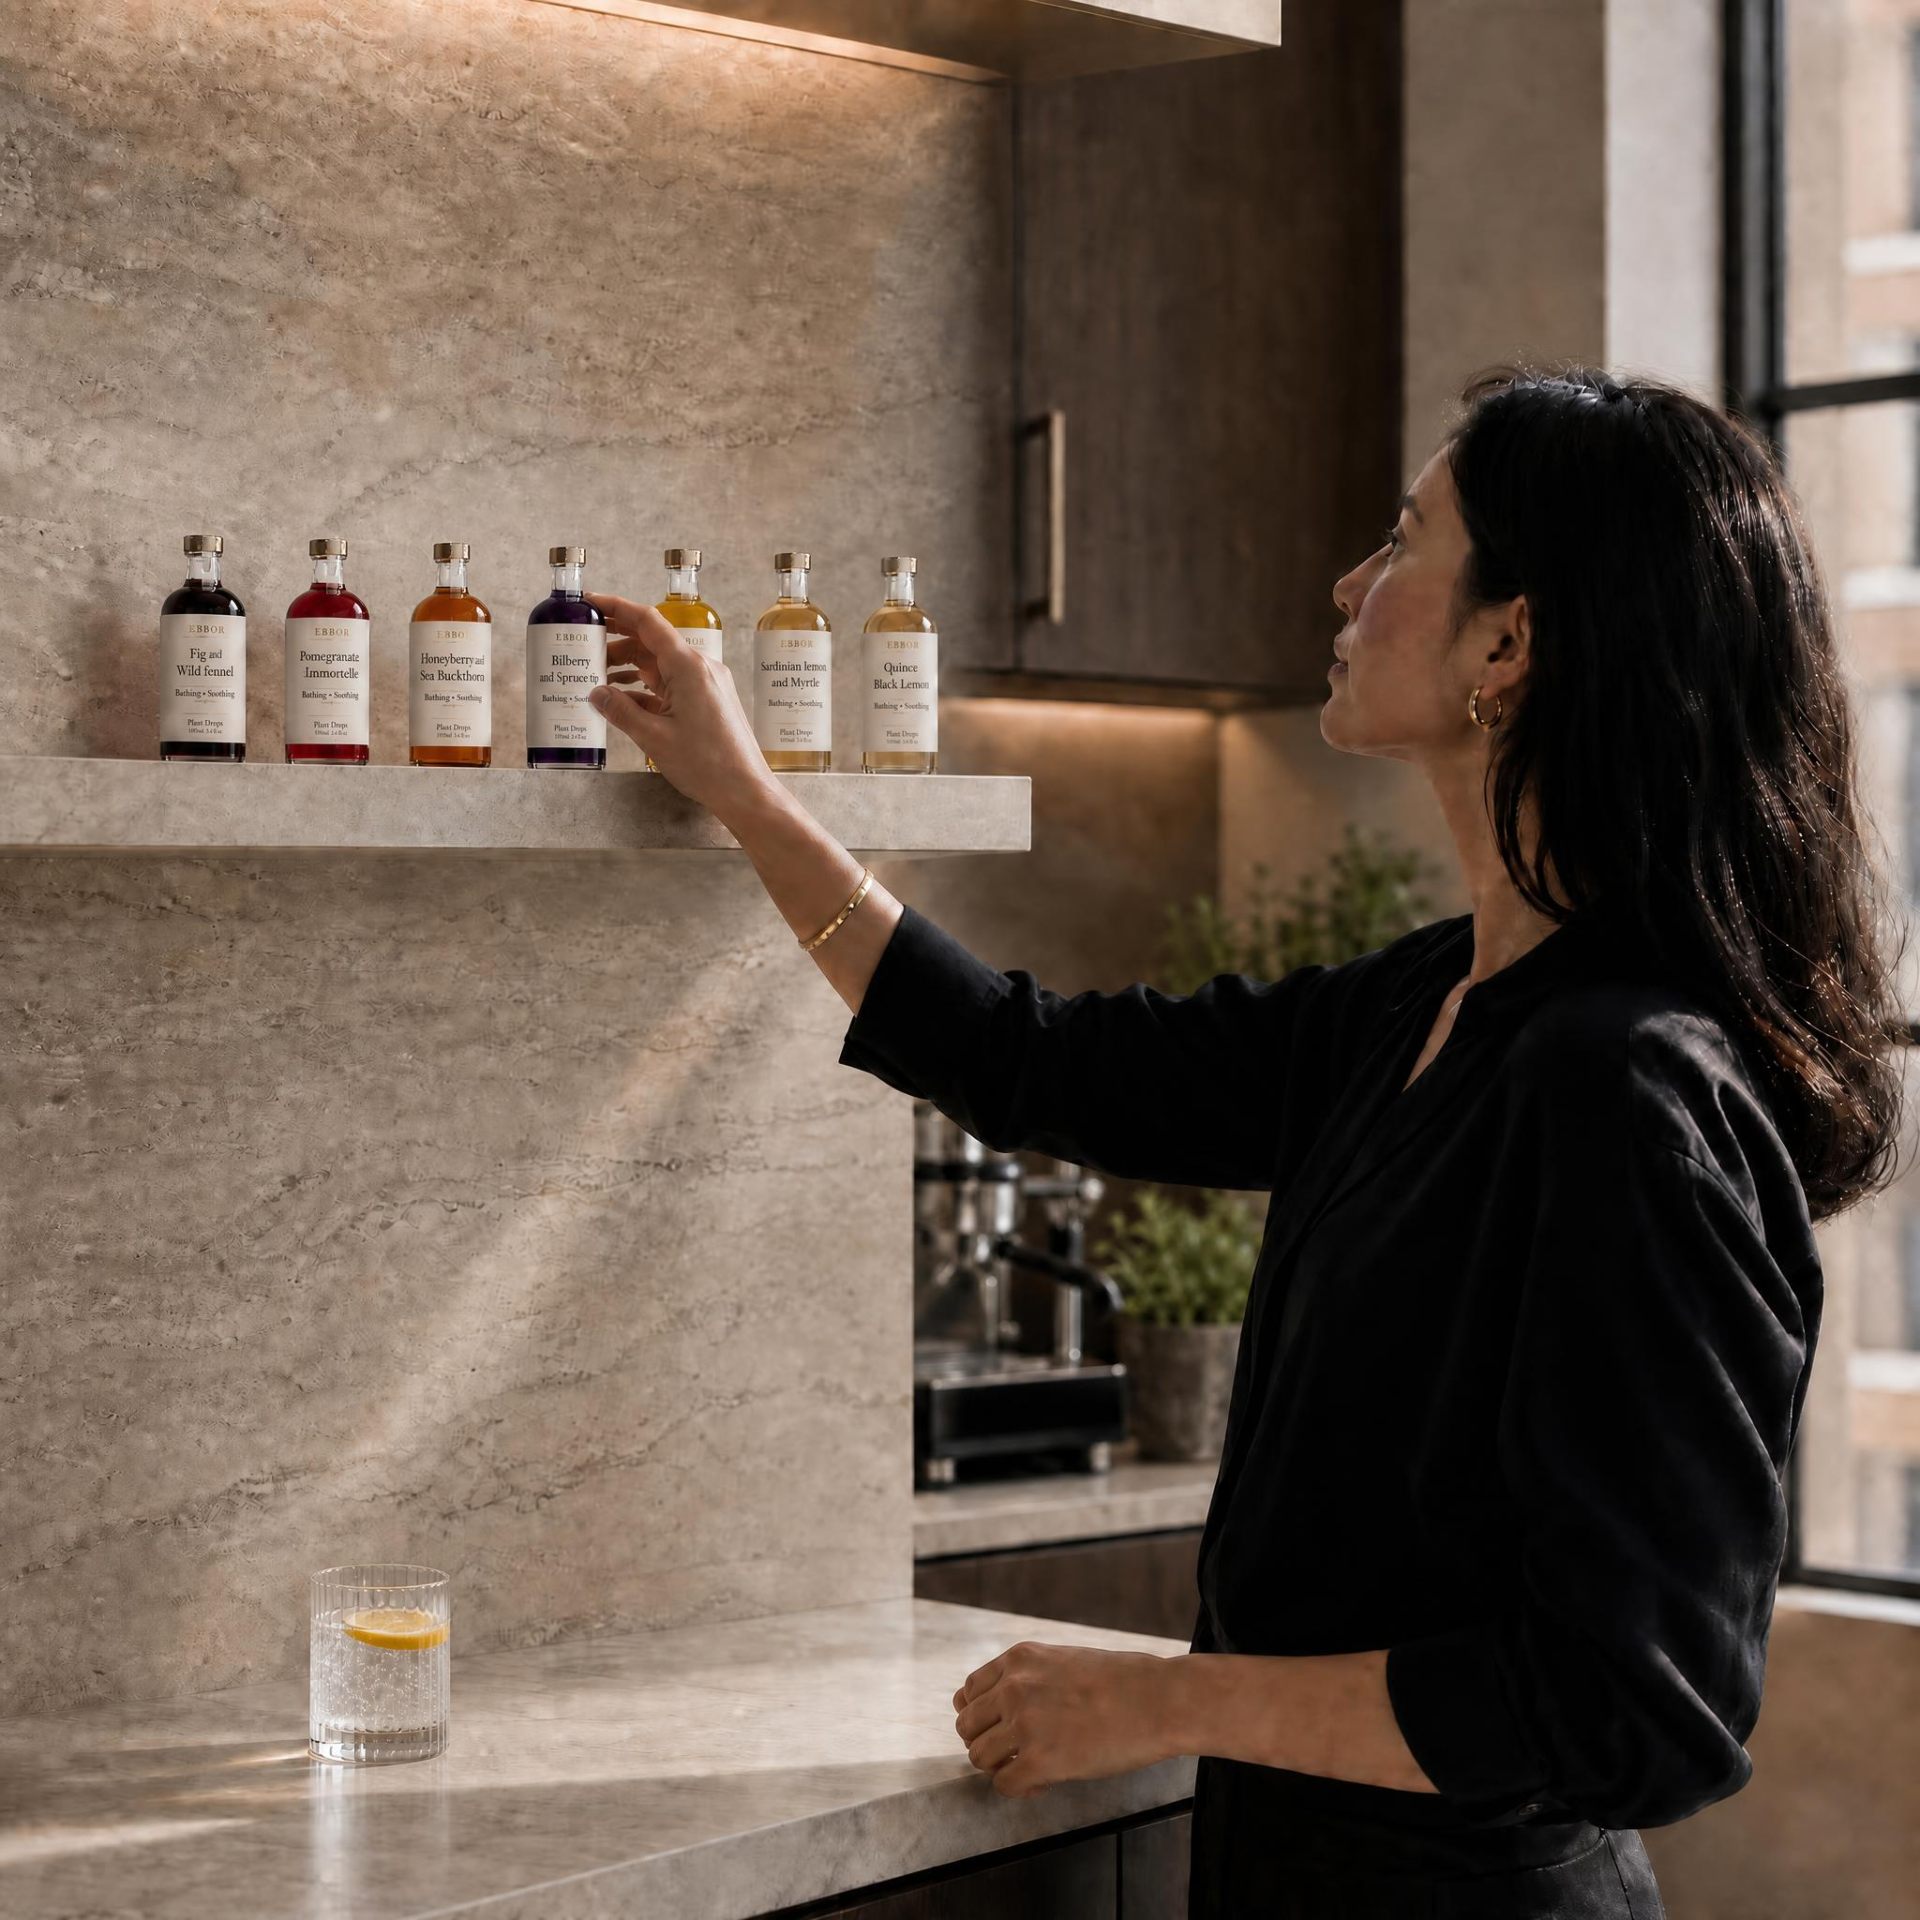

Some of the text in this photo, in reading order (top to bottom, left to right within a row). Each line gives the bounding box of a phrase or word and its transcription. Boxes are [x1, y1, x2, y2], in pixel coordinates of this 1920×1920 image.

[189, 624, 225, 634] EBBOR
[315, 627, 350, 637] EBBOR
[190, 648, 207, 663] Fig
[300, 650, 360, 664] Pomegranate
[420, 652, 474, 668] Honeyberry
[551, 654, 591, 669] Bilberry
[177, 664, 234, 677] Wild fennel
[303, 666, 359, 679] Immortelle
[760, 661, 827, 672] Sardinian lemon
[883, 662, 919, 676] Quince
[420, 670, 485, 682] Sea Buckthorn
[539, 672, 555, 683] and
[556, 671, 589, 685] Spruce
[771, 677, 821, 690] and Myrtle
[873, 679, 930, 690] Black Lemon
[175, 688, 236, 699] Bathing Soothing
[301, 690, 328, 700] Bathing
